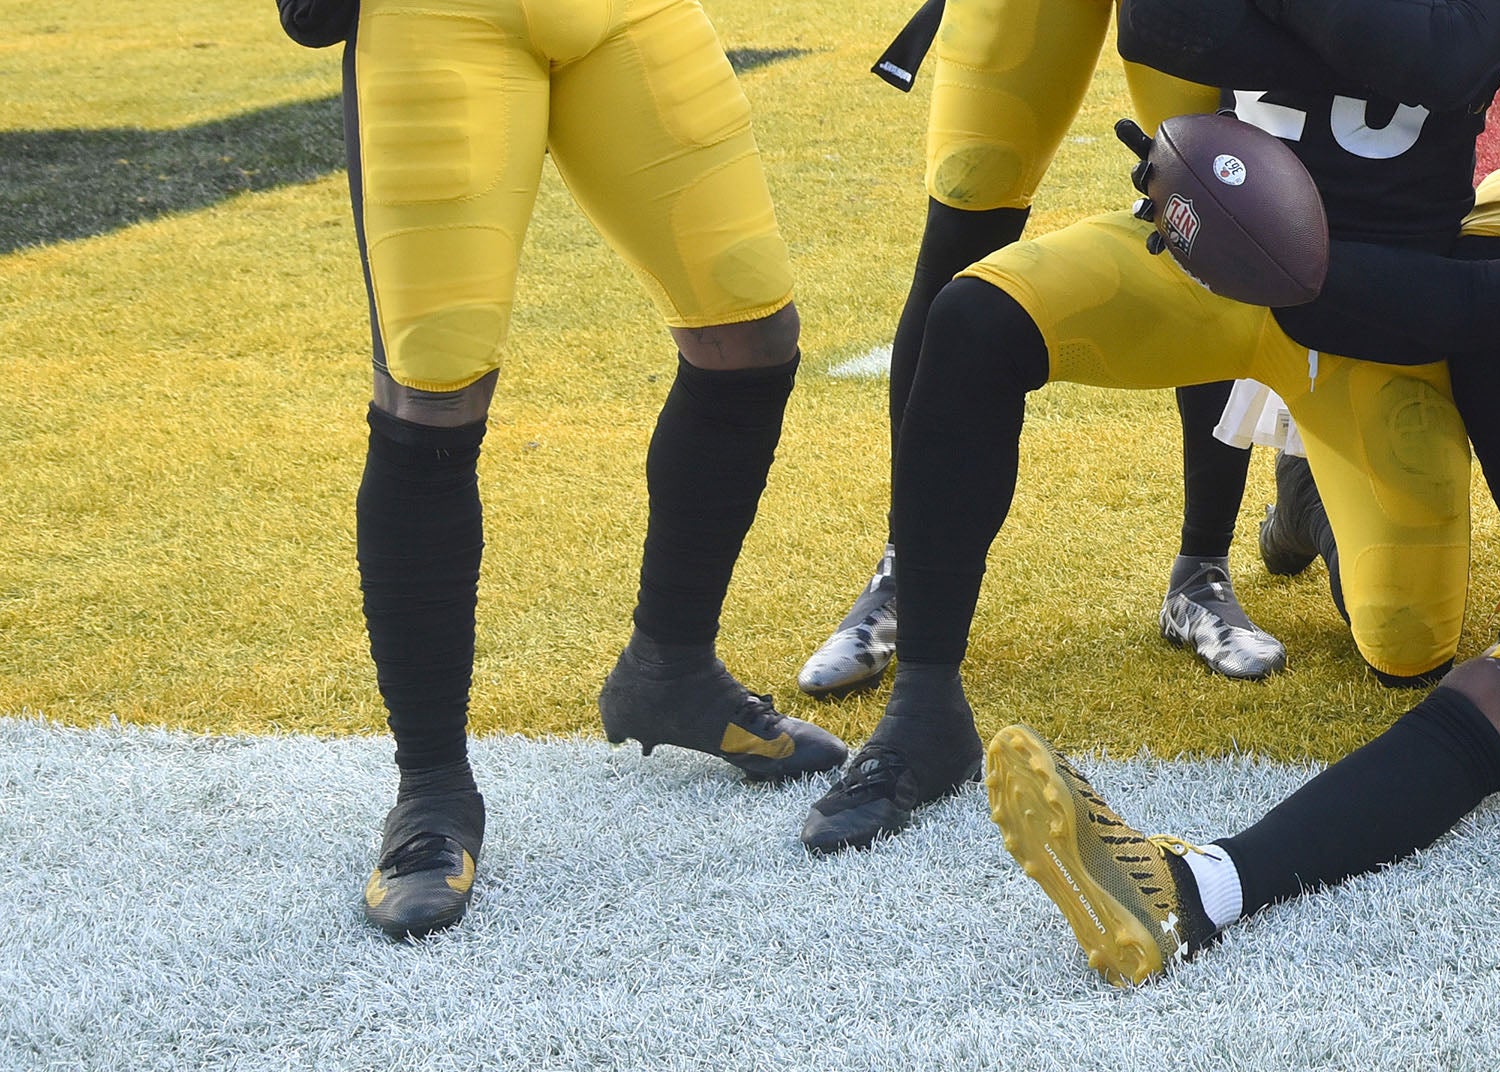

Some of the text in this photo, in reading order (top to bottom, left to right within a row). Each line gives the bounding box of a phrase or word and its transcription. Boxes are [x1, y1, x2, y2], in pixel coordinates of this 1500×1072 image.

[1168, 199, 1196, 241] NFL
[1044, 842, 1107, 935] UNDER ARMOUR
